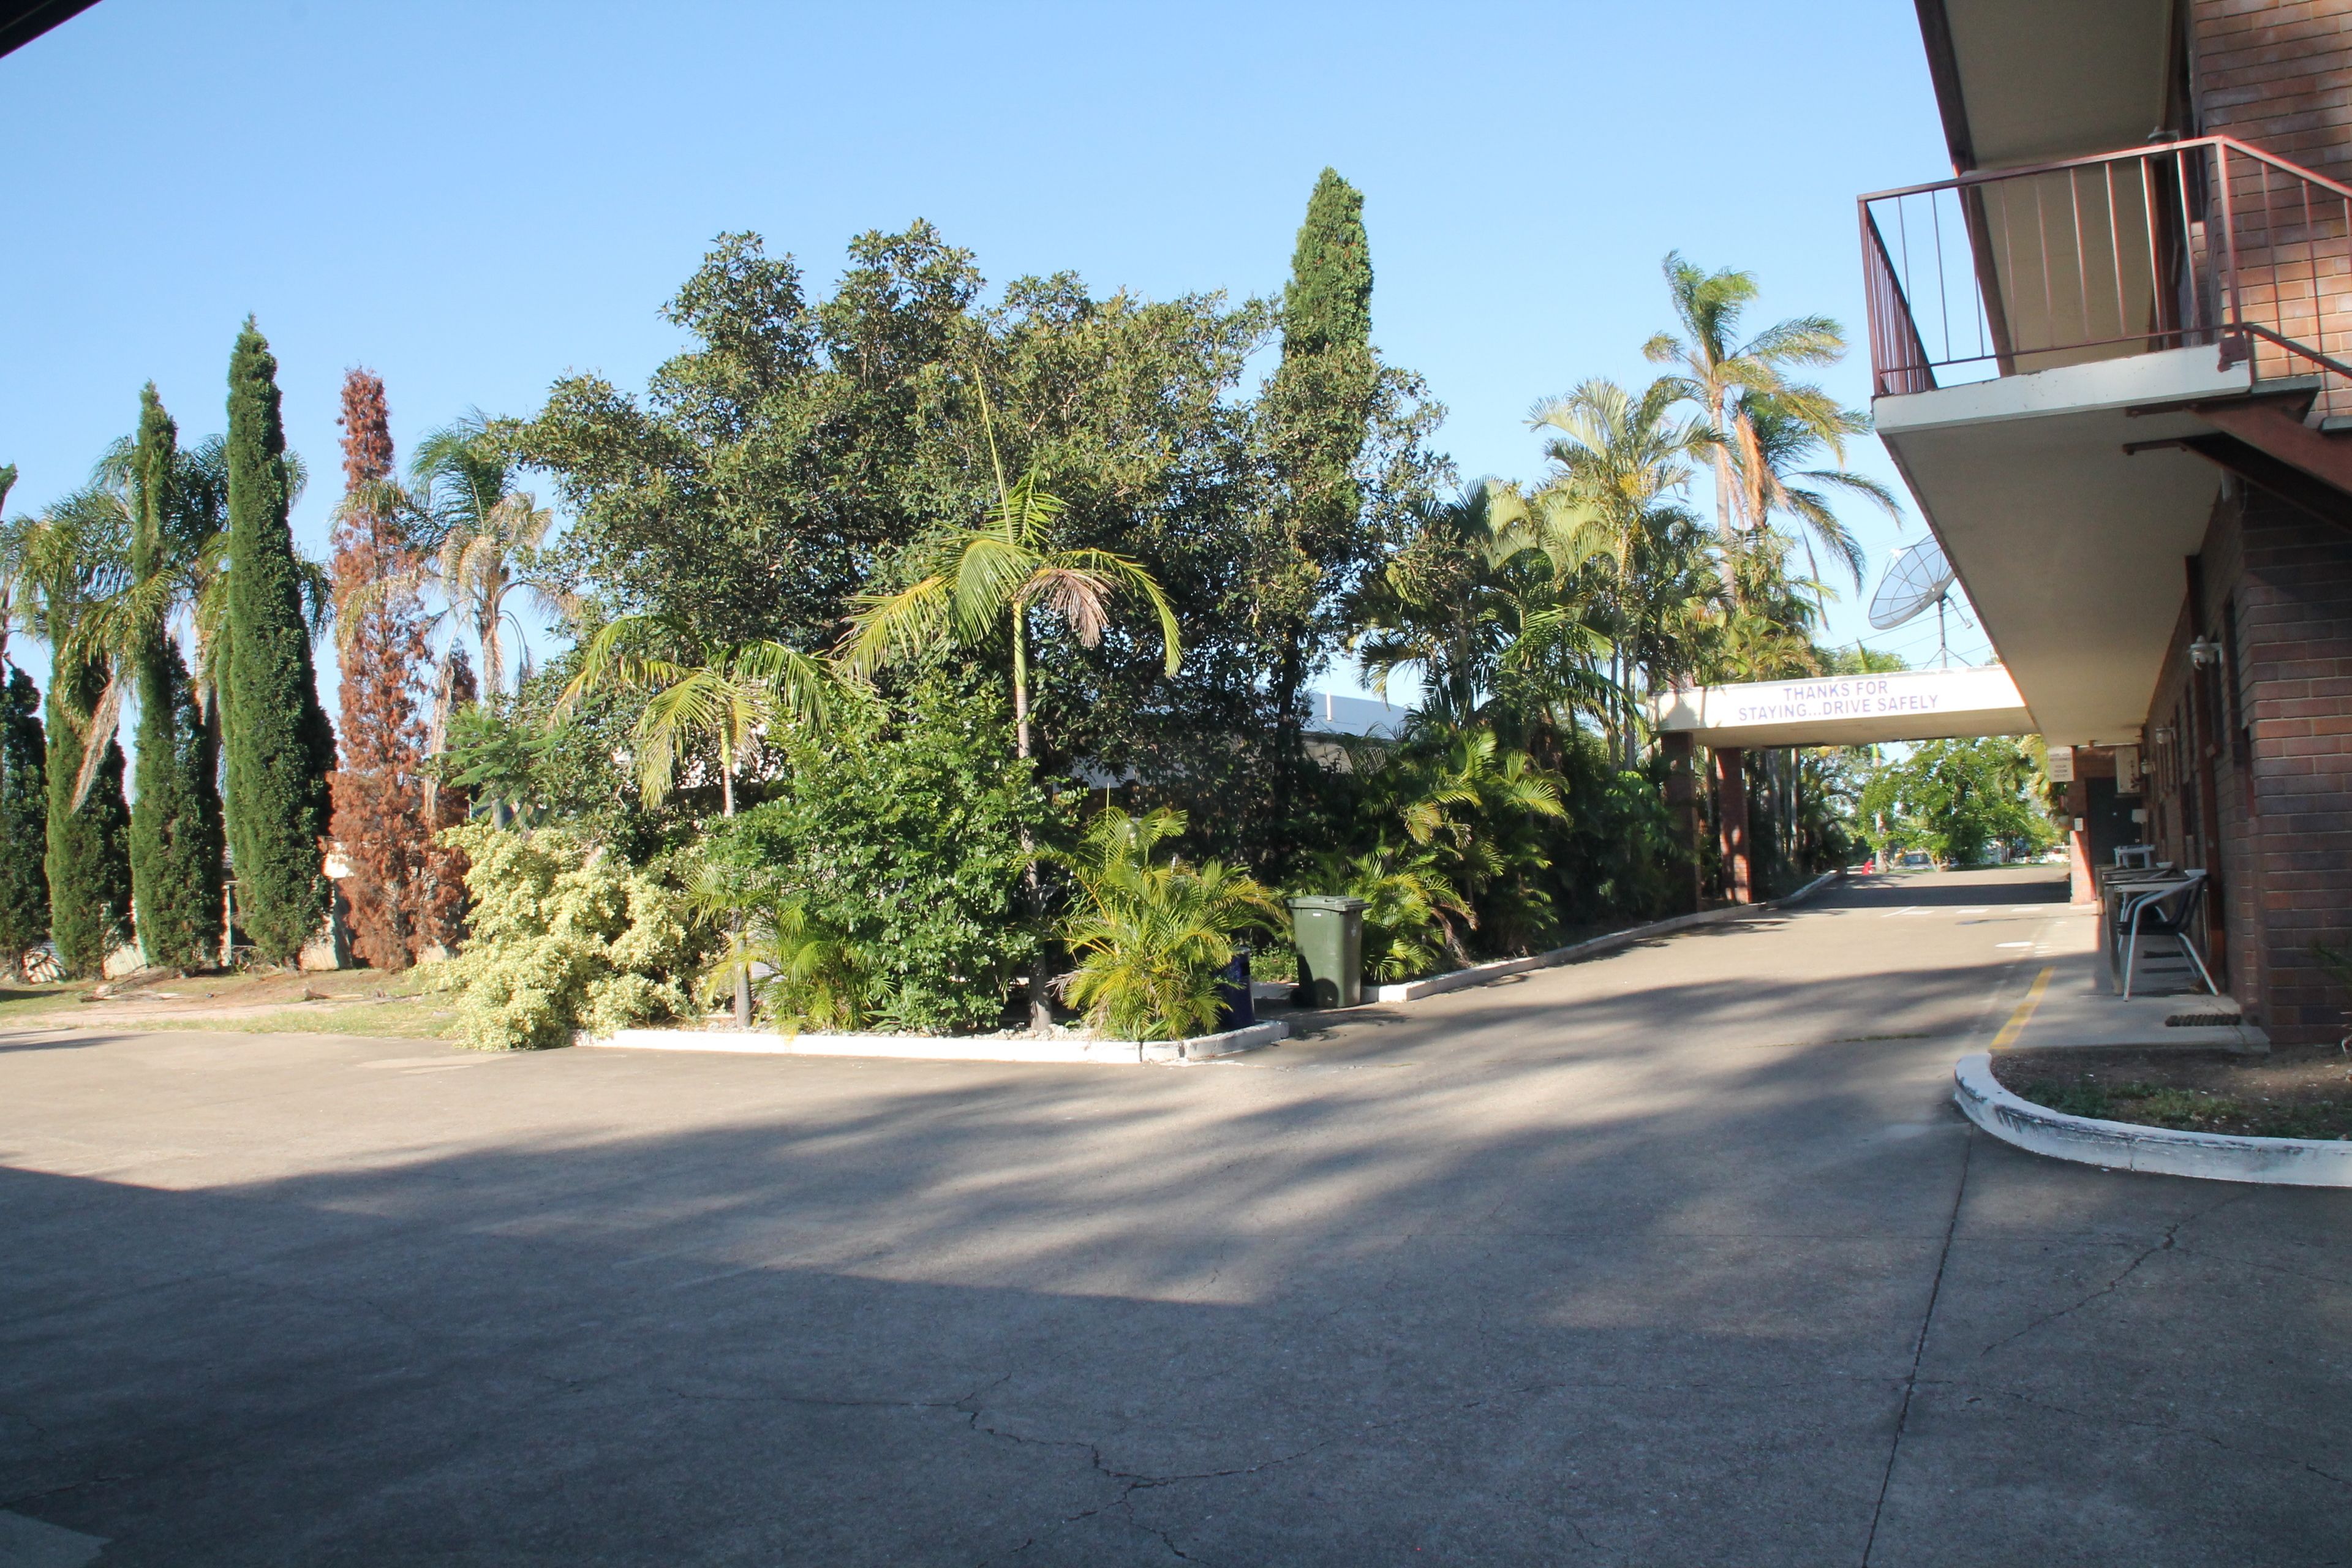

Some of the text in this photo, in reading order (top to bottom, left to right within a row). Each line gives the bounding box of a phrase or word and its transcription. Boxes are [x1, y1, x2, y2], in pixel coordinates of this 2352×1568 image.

[1783, 680, 1888, 701] THANKS FOR
[1877, 694, 1939, 712] SAFELY
